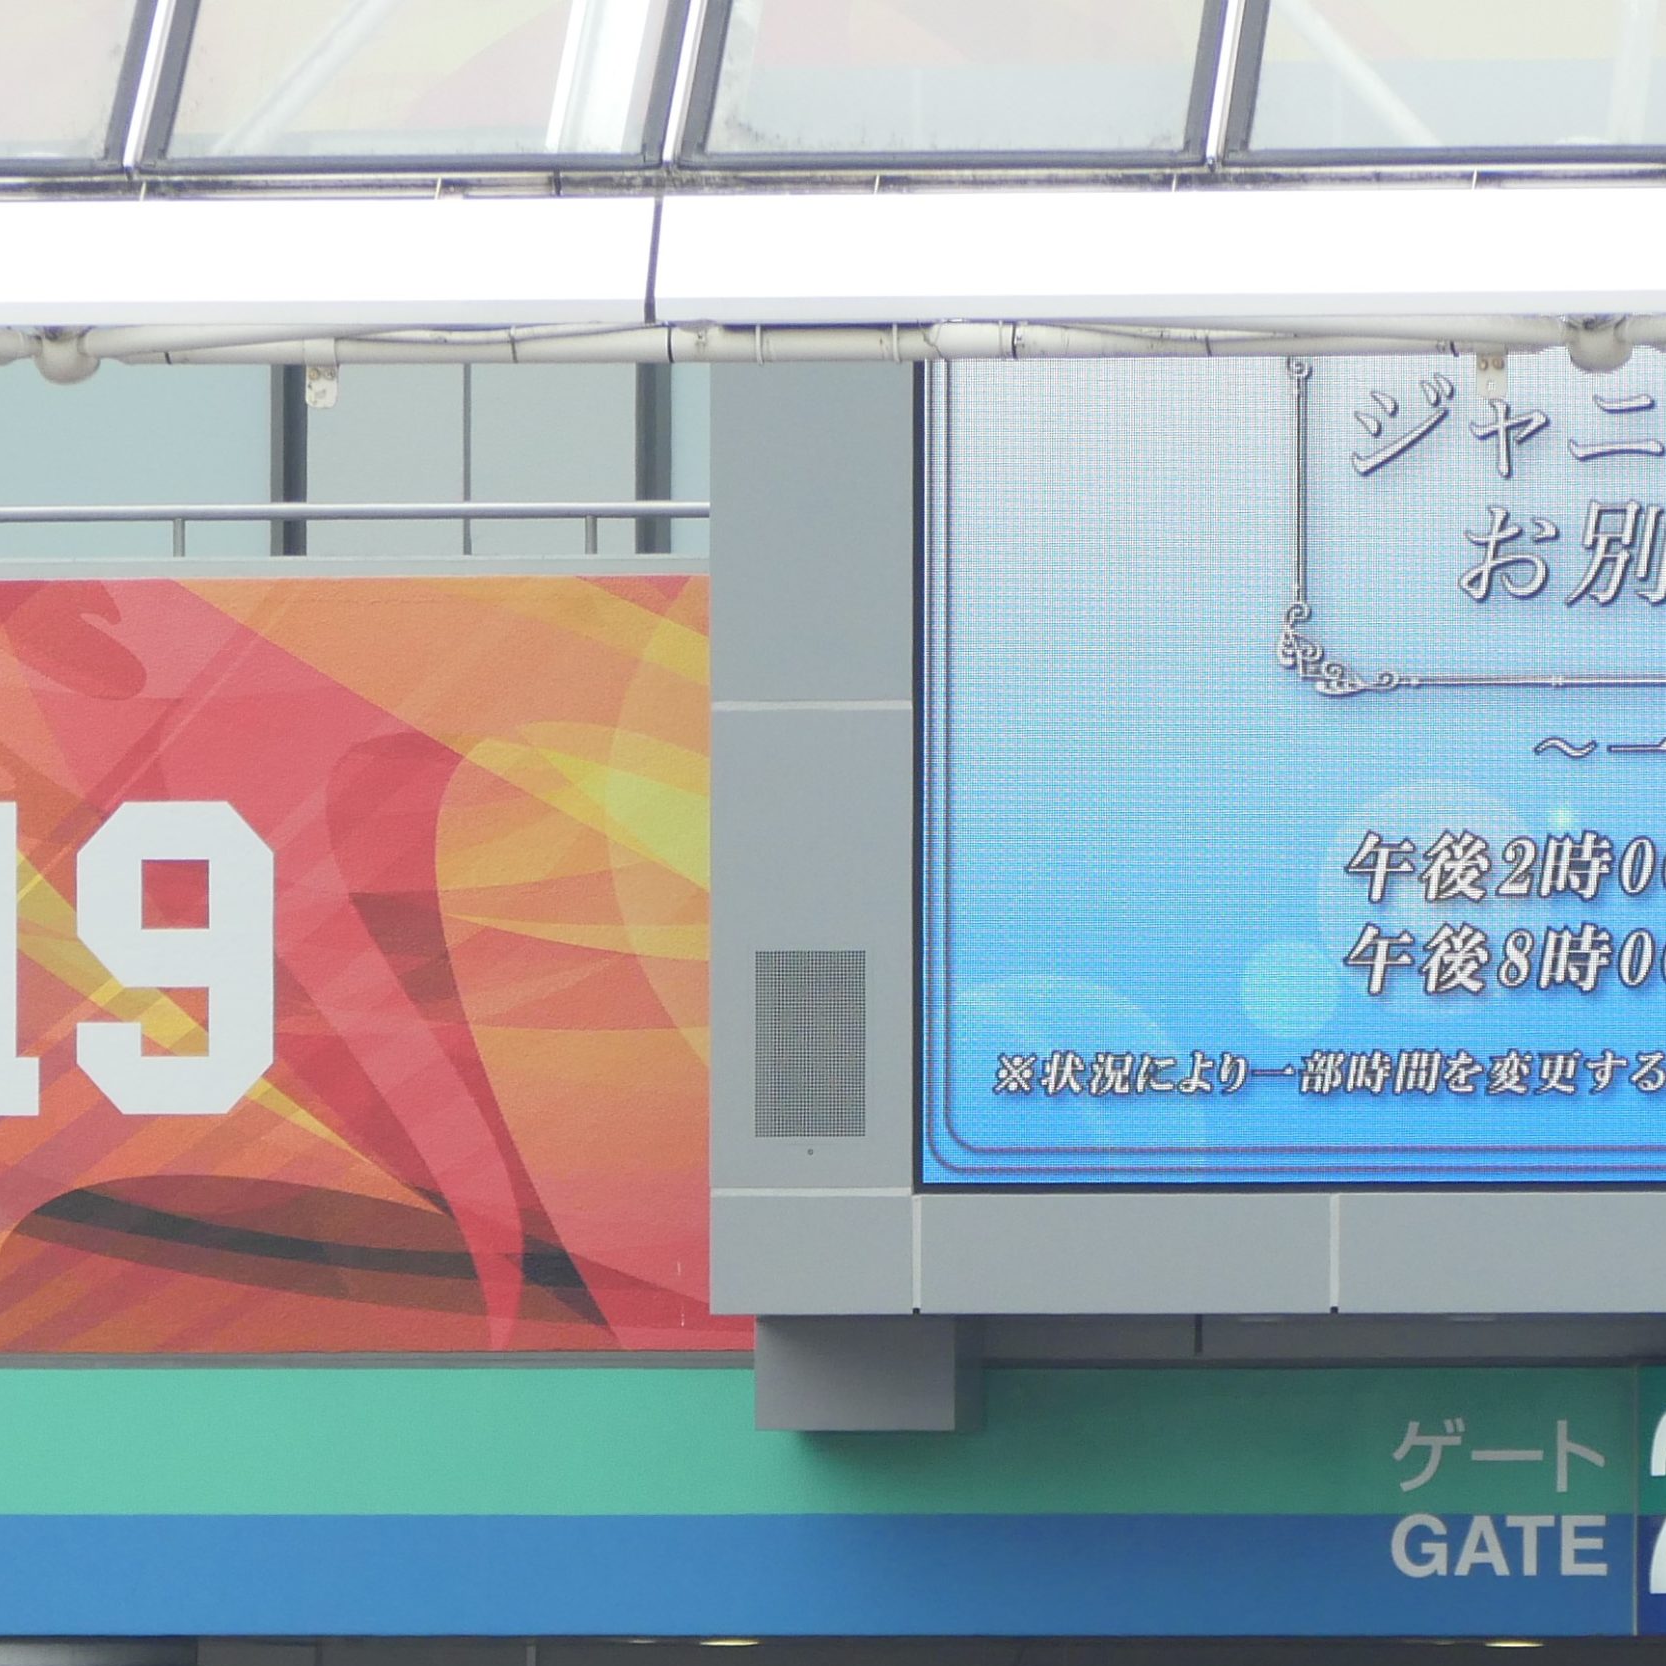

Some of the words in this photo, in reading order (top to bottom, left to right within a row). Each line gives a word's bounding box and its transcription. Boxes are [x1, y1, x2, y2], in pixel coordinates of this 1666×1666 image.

[1392, 1417, 1606, 1494] ゲート
[1389, 1513, 1609, 1579] GATE
